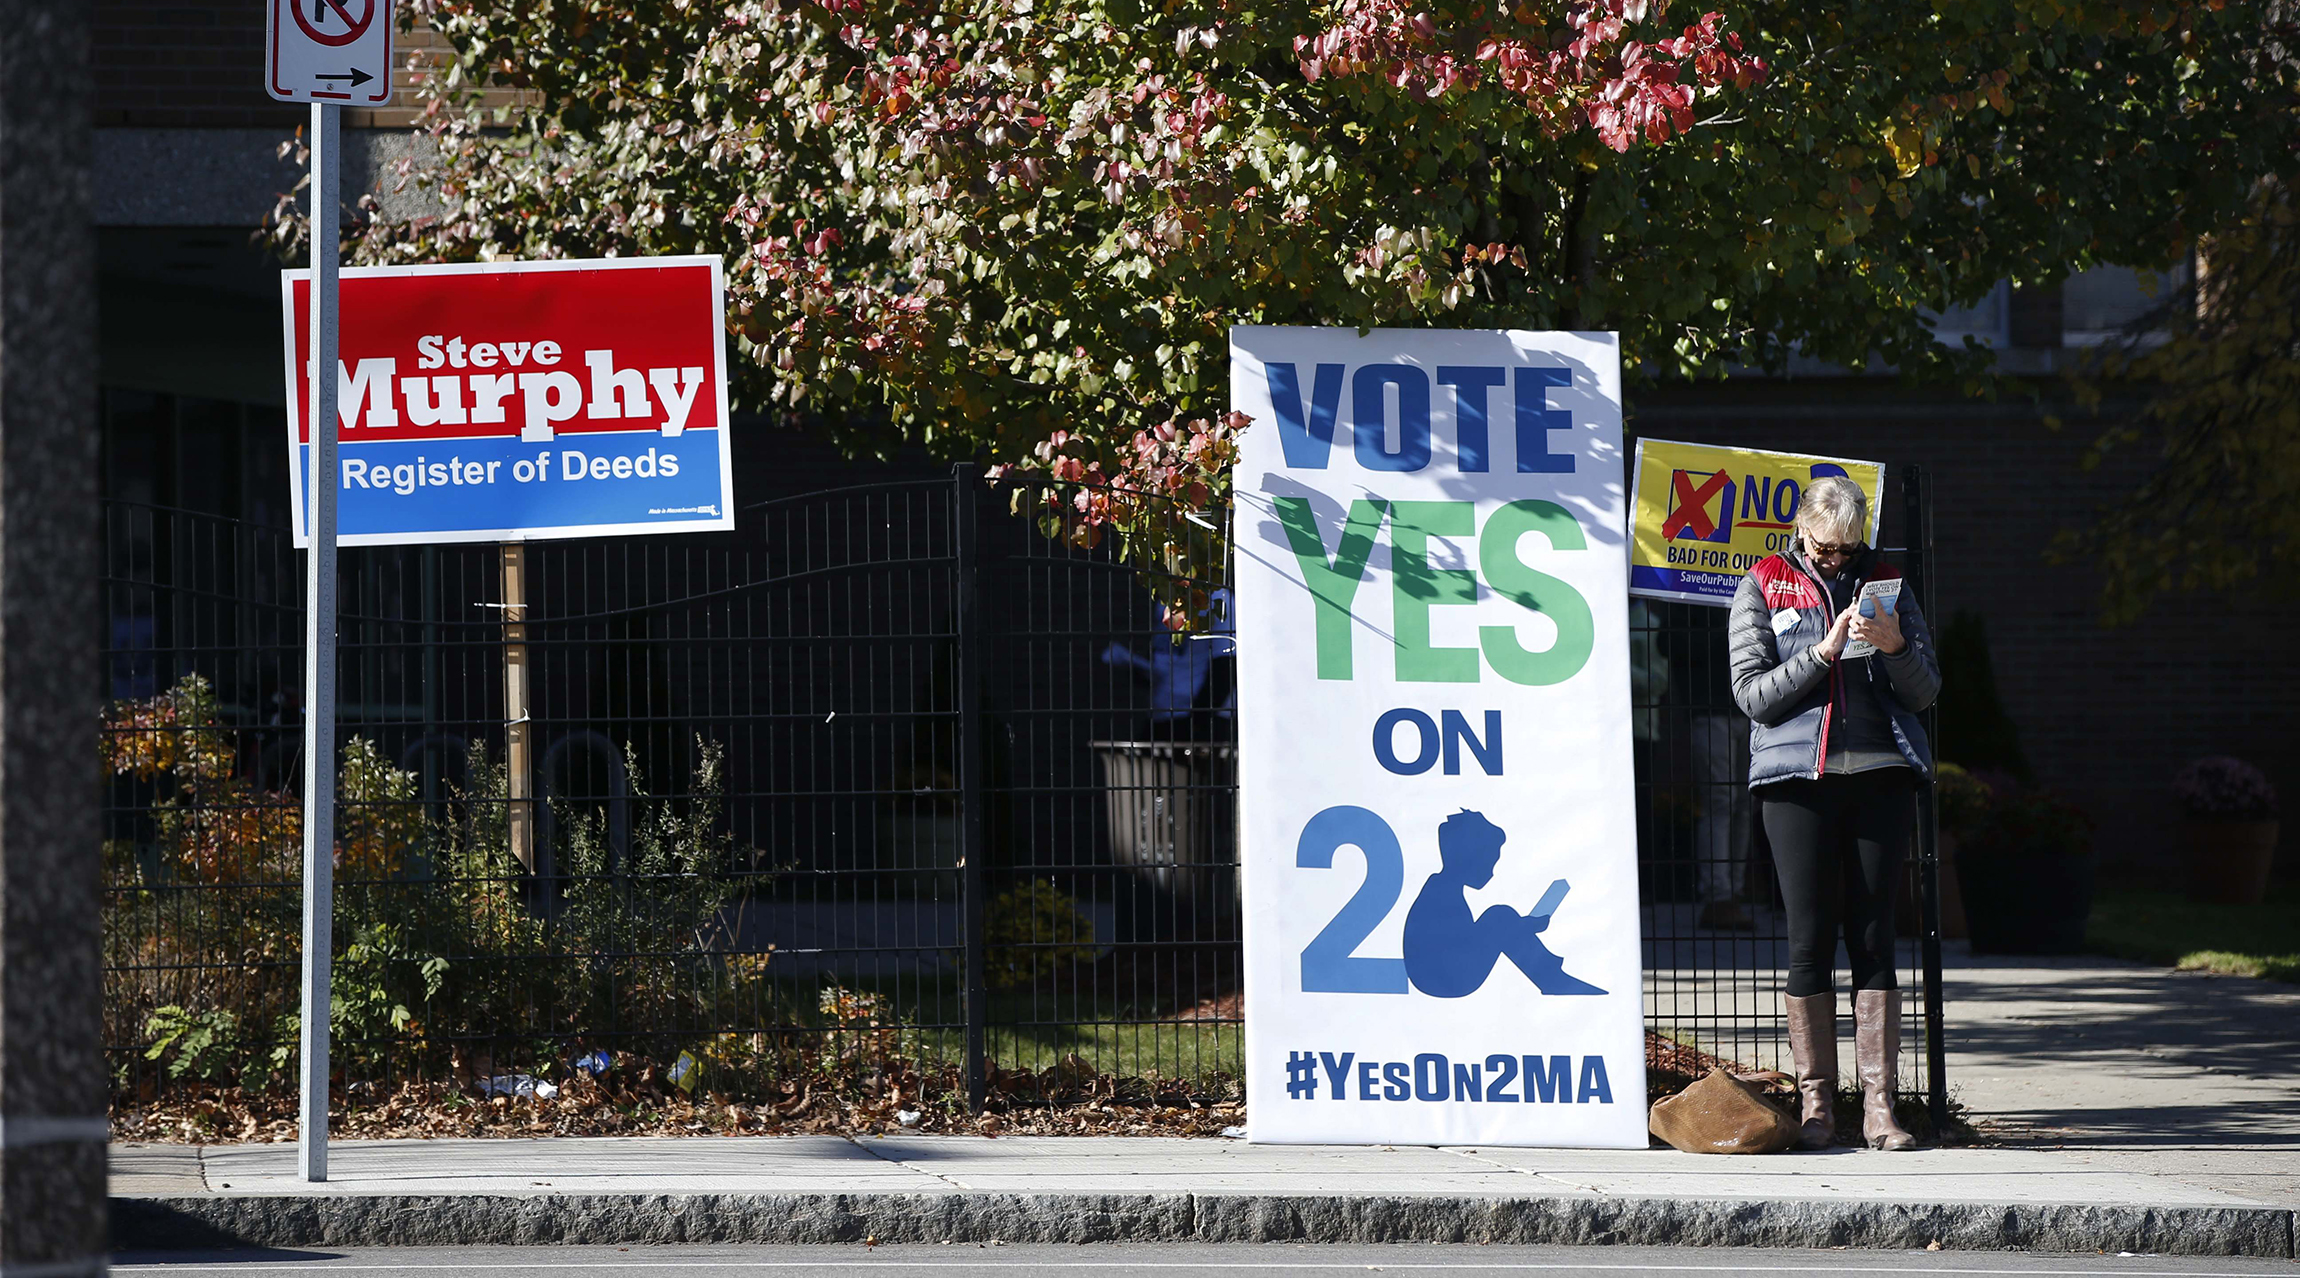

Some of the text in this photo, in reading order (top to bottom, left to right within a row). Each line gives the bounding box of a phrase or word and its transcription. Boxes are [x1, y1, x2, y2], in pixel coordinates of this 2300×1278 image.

[417, 335, 562, 370] Steve
[308, 350, 704, 442] Murphy
[1264, 362, 1576, 473] VOTE
[342, 447, 680, 495] Register of Deeds
[1741, 475, 1800, 523] NO
[1667, 546, 1698, 565] BAD
[1700, 549, 1729, 569] FOR
[1765, 532, 1791, 551] on
[1271, 496, 1595, 686] YES
[1680, 571, 1741, 587] SaveOurPubli
[1372, 707, 1504, 777] ON
[1295, 804, 1411, 995] 2
